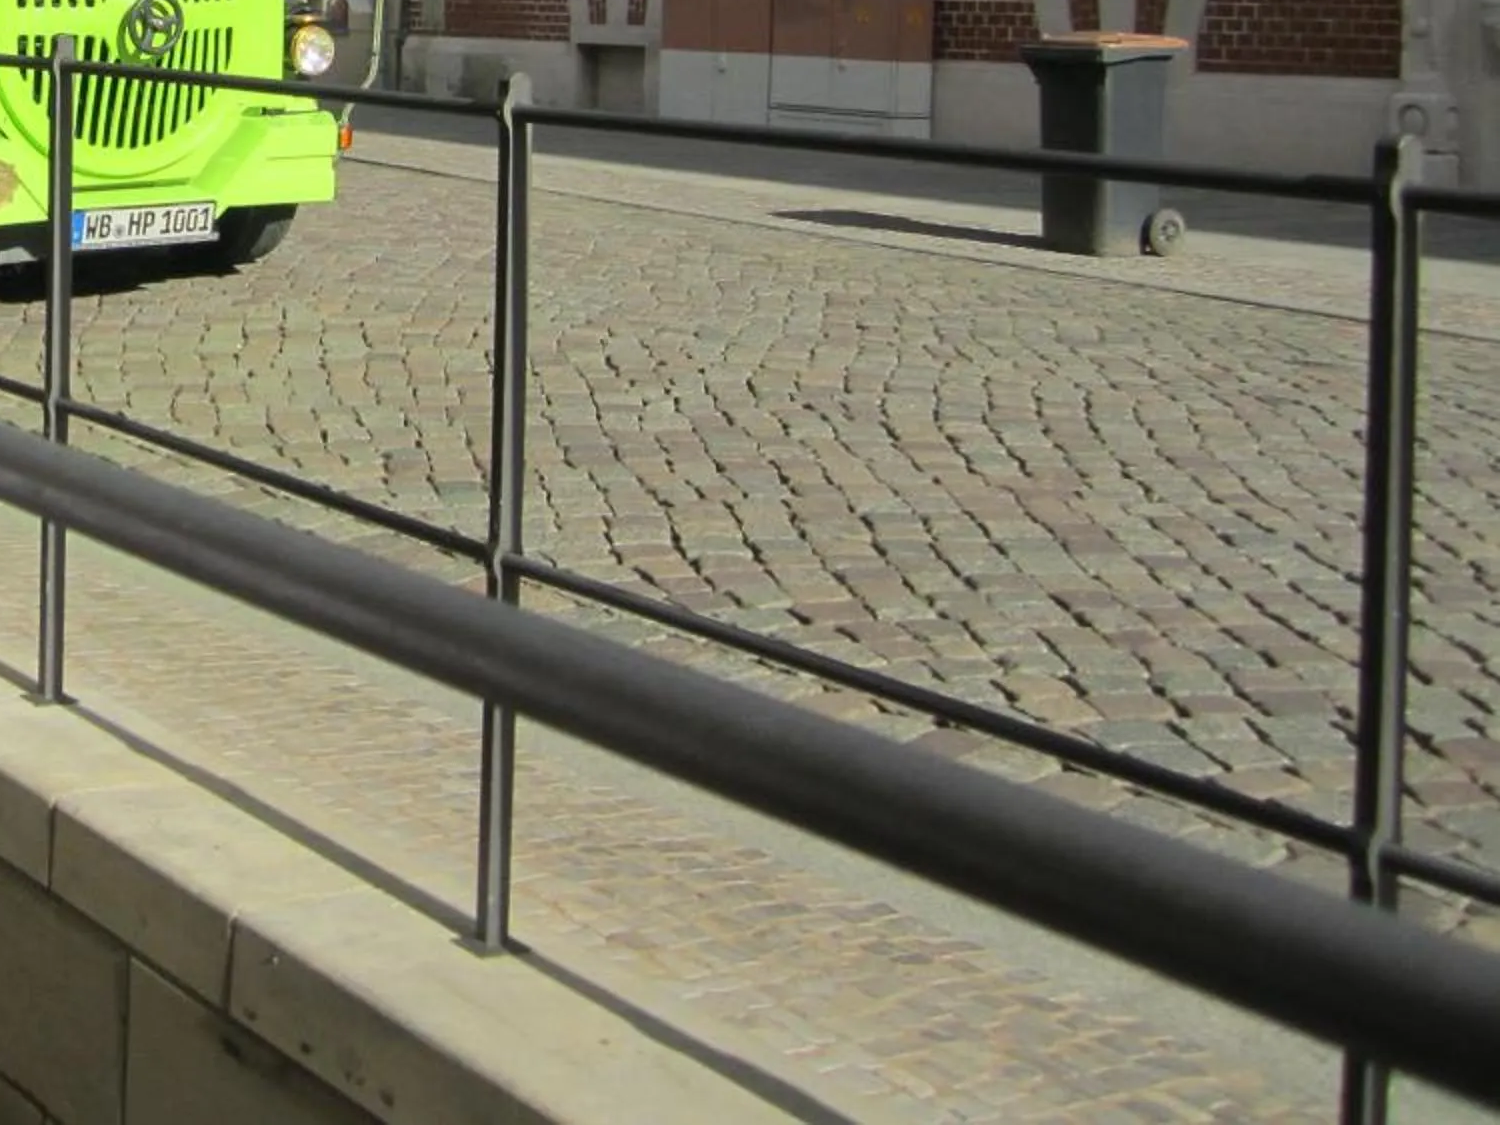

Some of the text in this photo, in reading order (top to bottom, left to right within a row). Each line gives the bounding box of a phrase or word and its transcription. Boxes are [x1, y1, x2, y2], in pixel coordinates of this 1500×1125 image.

[86, 207, 210, 239] WB HP 1001
